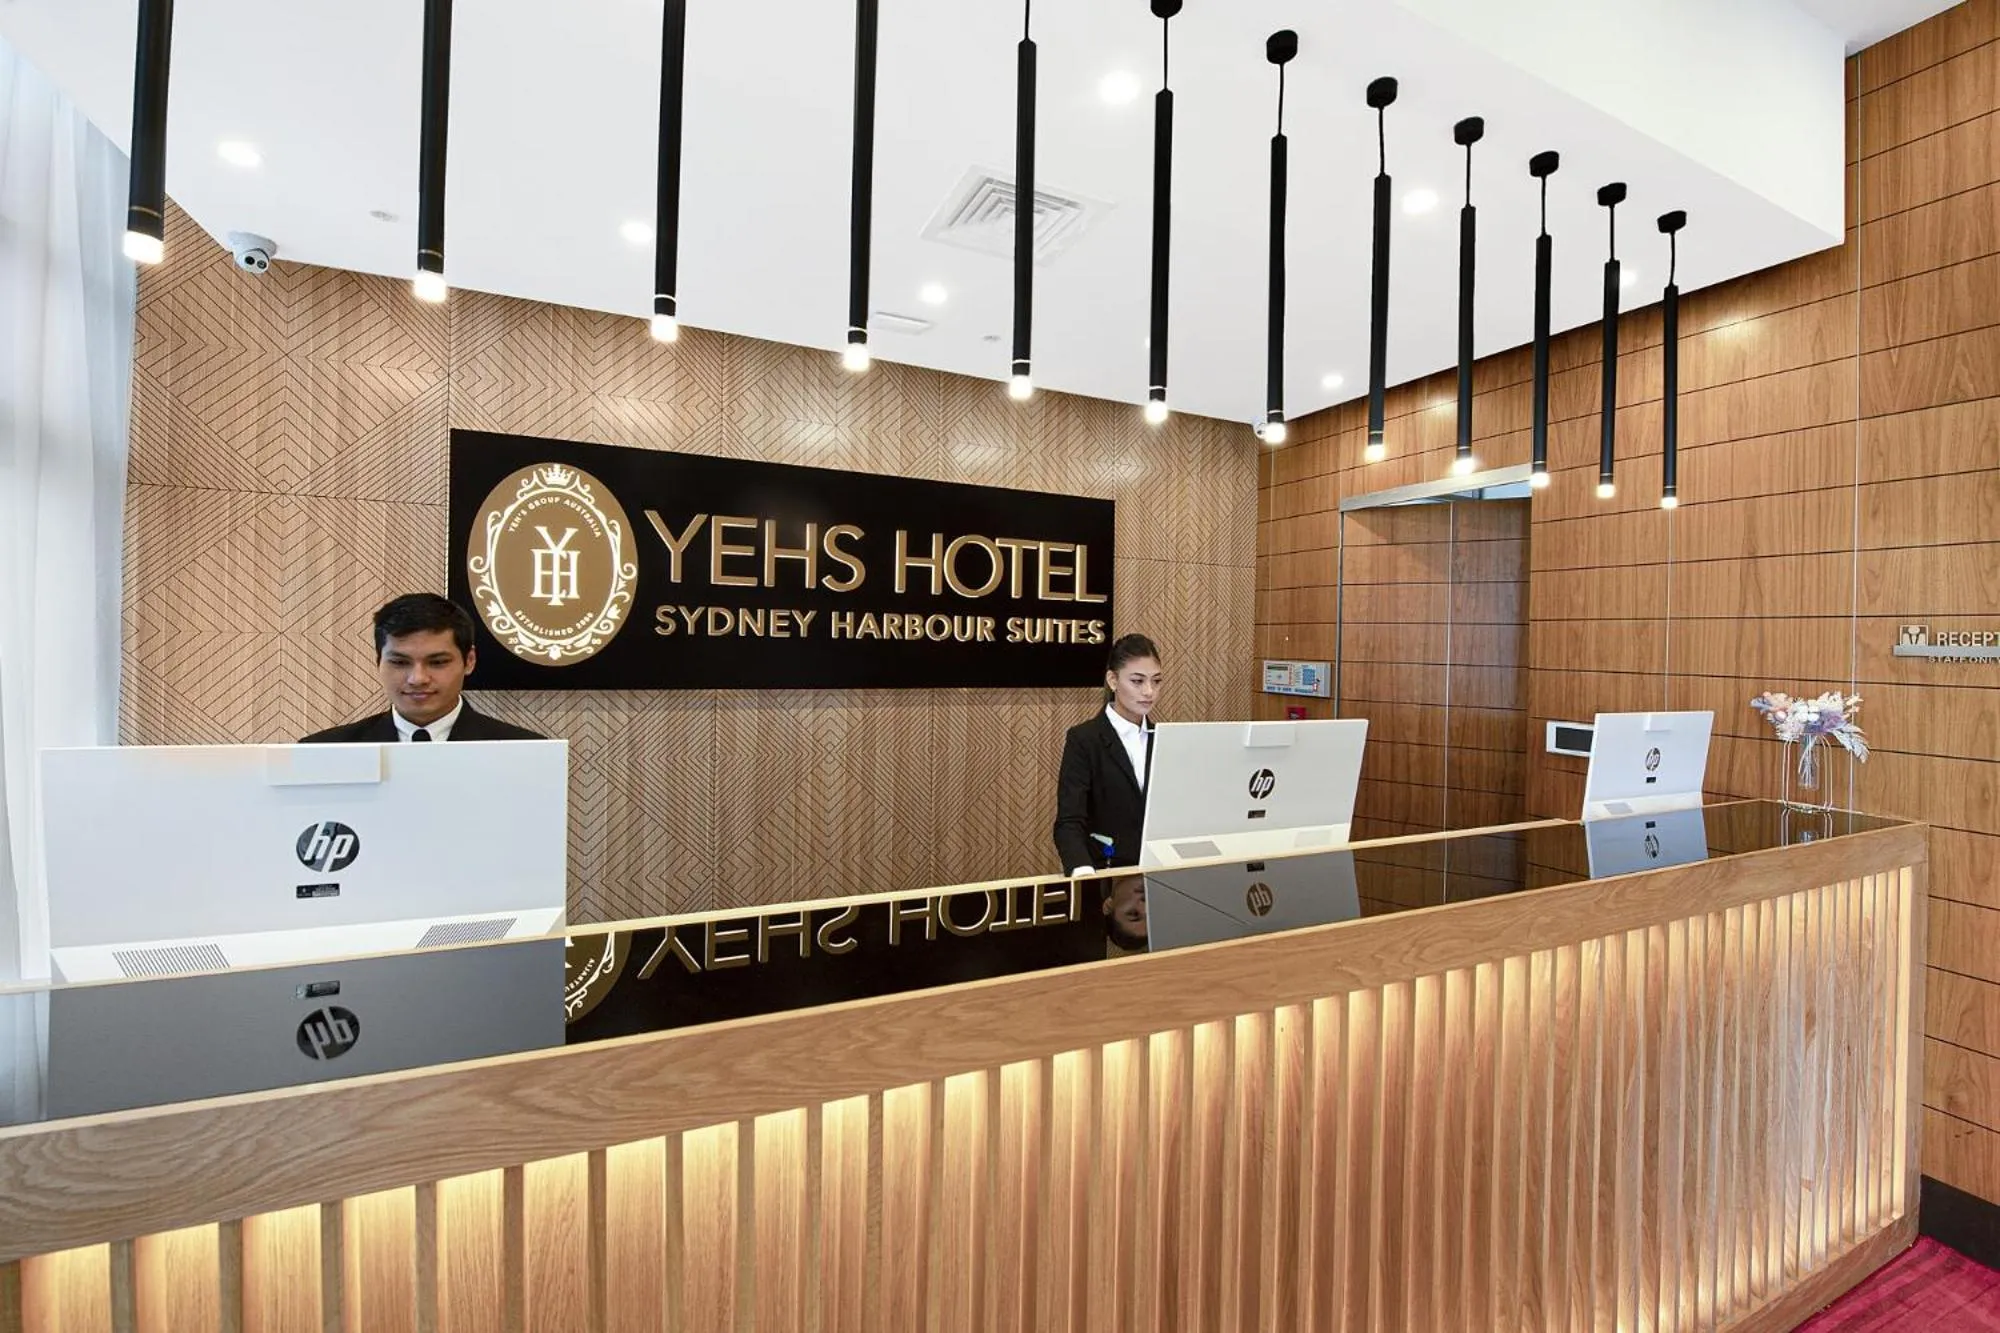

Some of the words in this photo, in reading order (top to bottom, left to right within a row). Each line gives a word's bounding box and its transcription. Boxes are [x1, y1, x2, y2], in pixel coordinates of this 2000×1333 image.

[528, 496, 560, 510] GROUP
[563, 499, 601, 538] AUSTRALIA
[644, 509, 866, 593] YEHS
[895, 529, 1108, 603] HOTEL
[514, 610, 574, 636] ESTABLISHED
[654, 604, 818, 637] SYDNEY
[831, 611, 996, 642] HARBOUR
[1006, 616, 1106, 645] SUITES
[1250, 768, 1274, 799] hp
[302, 821, 356, 872] hp
